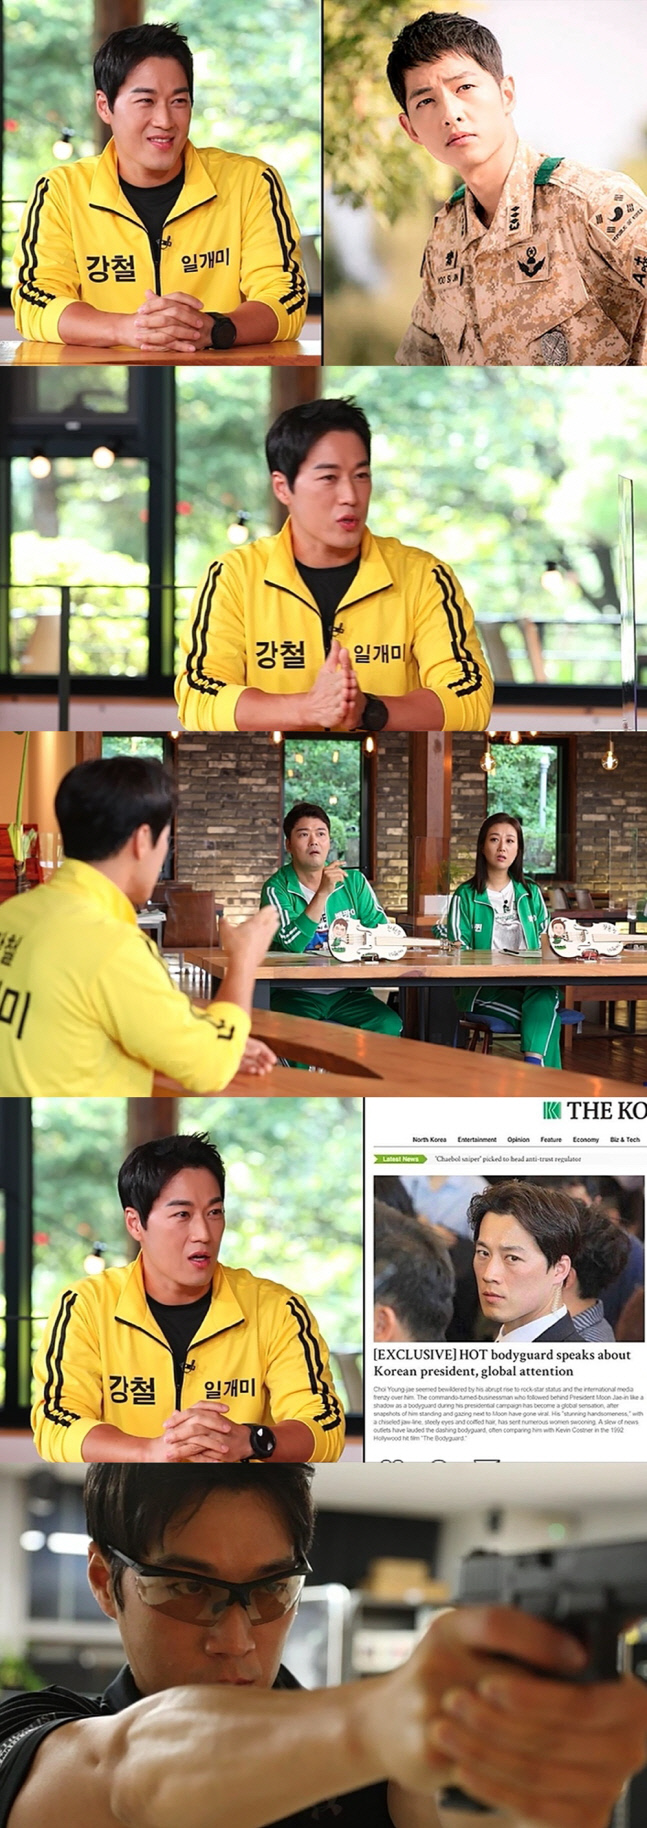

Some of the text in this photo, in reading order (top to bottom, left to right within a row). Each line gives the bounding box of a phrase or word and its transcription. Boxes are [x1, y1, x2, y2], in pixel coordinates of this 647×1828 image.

[86, 247, 230, 283] 강철 일개미
[255, 640, 406, 669] 강철 일개미
[566, 1101, 612, 1120] THE
[618, 1101, 647, 1120] KO
[482, 1156, 502, 1164] picked
[374, 1348, 632, 1362] [EXCLUSIVE] HOT bodyguard speaks about
[374, 1365, 574, 1379] Korean president, global attention
[109, 1376, 256, 1405] 강철 일개미
